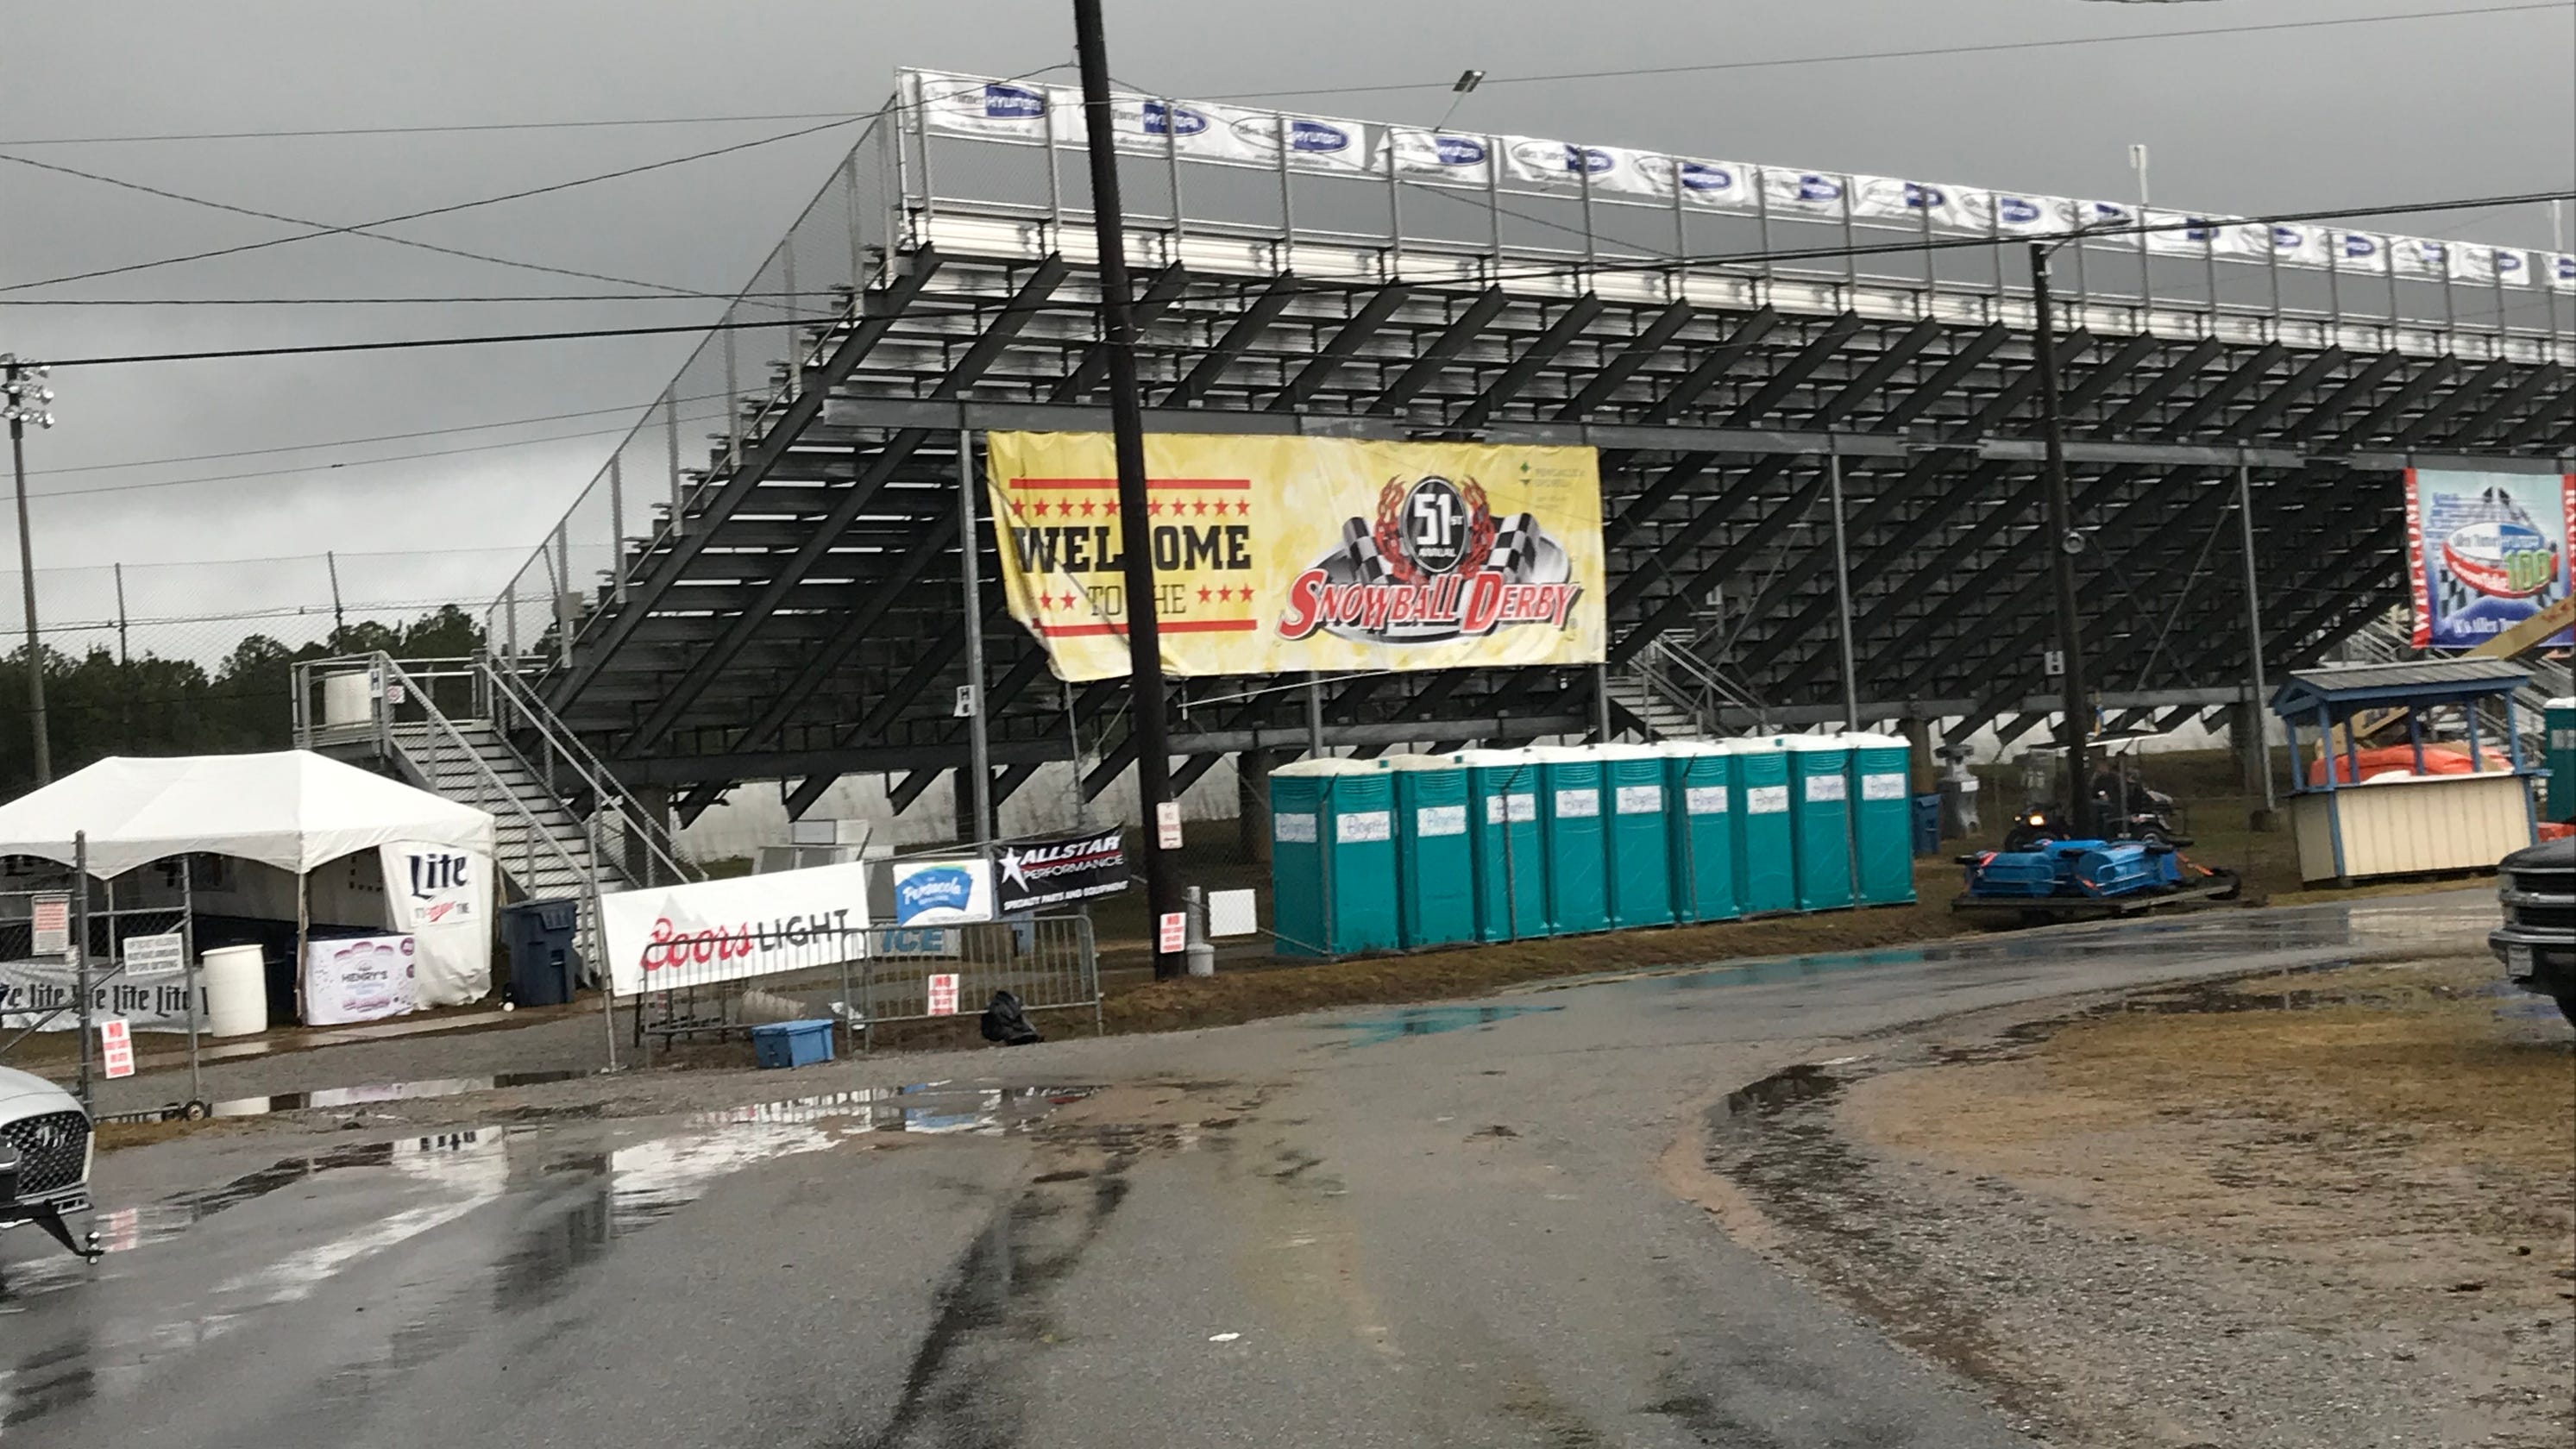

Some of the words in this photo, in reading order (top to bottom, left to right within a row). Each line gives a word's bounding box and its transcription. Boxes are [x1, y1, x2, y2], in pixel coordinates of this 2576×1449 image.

[1012, 524, 1252, 573] WELOME
[2504, 549, 2551, 591] 100
[1088, 585, 1122, 616] TO
[1020, 835, 1122, 865] ALLSTAR
[408, 853, 468, 900] Lite
[1023, 854, 1124, 880] PERFORMANCE
[639, 918, 754, 971] Coors
[757, 908, 849, 952] LIGHT
[882, 927, 946, 953] ICE
[112, 985, 149, 1017] Lite
